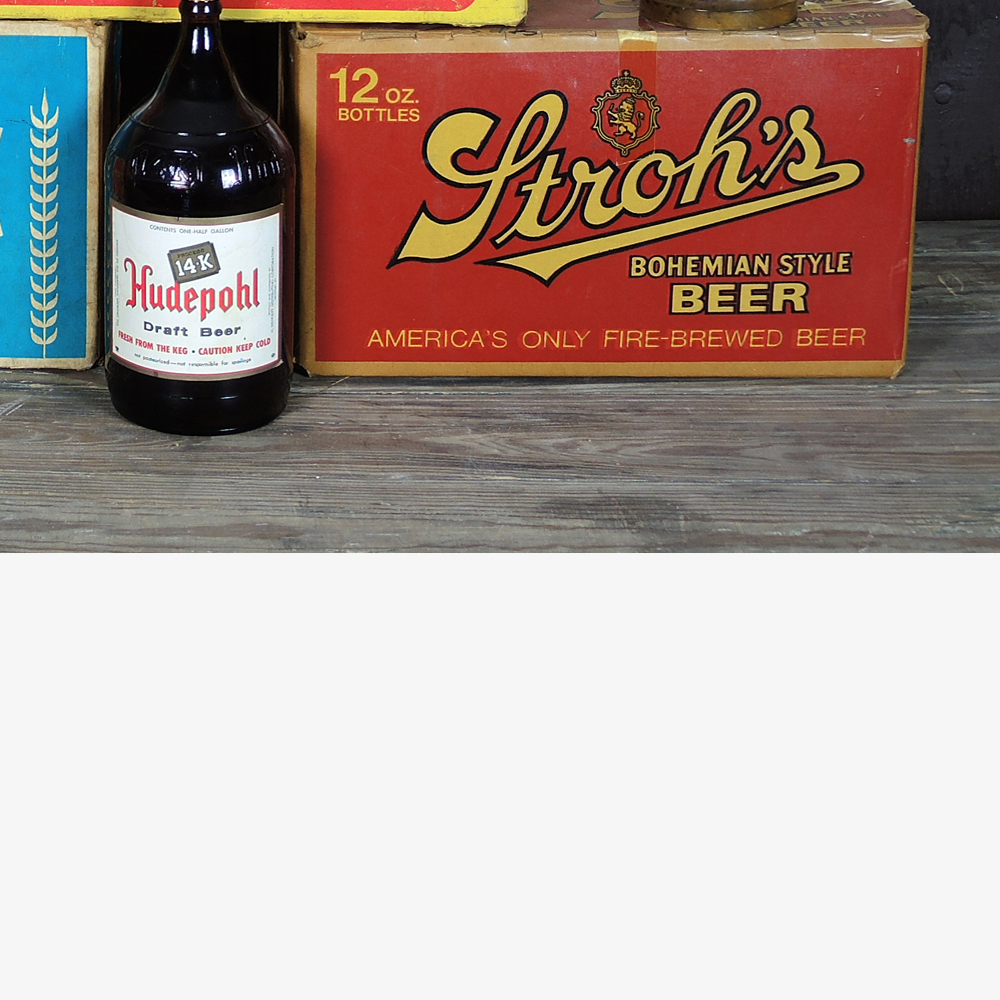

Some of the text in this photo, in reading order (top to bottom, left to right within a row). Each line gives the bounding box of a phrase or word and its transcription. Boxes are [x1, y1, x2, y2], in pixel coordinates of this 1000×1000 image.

[328, 66, 380, 105] 12
[337, 106, 421, 124] BOTTLES
[386, 88, 862, 275] Stroh's
[149, 224, 177, 234] CONTENTS
[210, 226, 234, 235] GALLON
[628, 250, 853, 280] BOHEMIAN STYLE
[123, 257, 261, 322] Hudepohl
[668, 281, 812, 316] BEER
[118, 329, 272, 356] FRESH FROM THE KEG CAUTION KEEP COLD
[143, 320, 242, 338] Draft Beer
[365, 326, 867, 350] AMERICA'S ONLY FIRE-BREWED BEER
